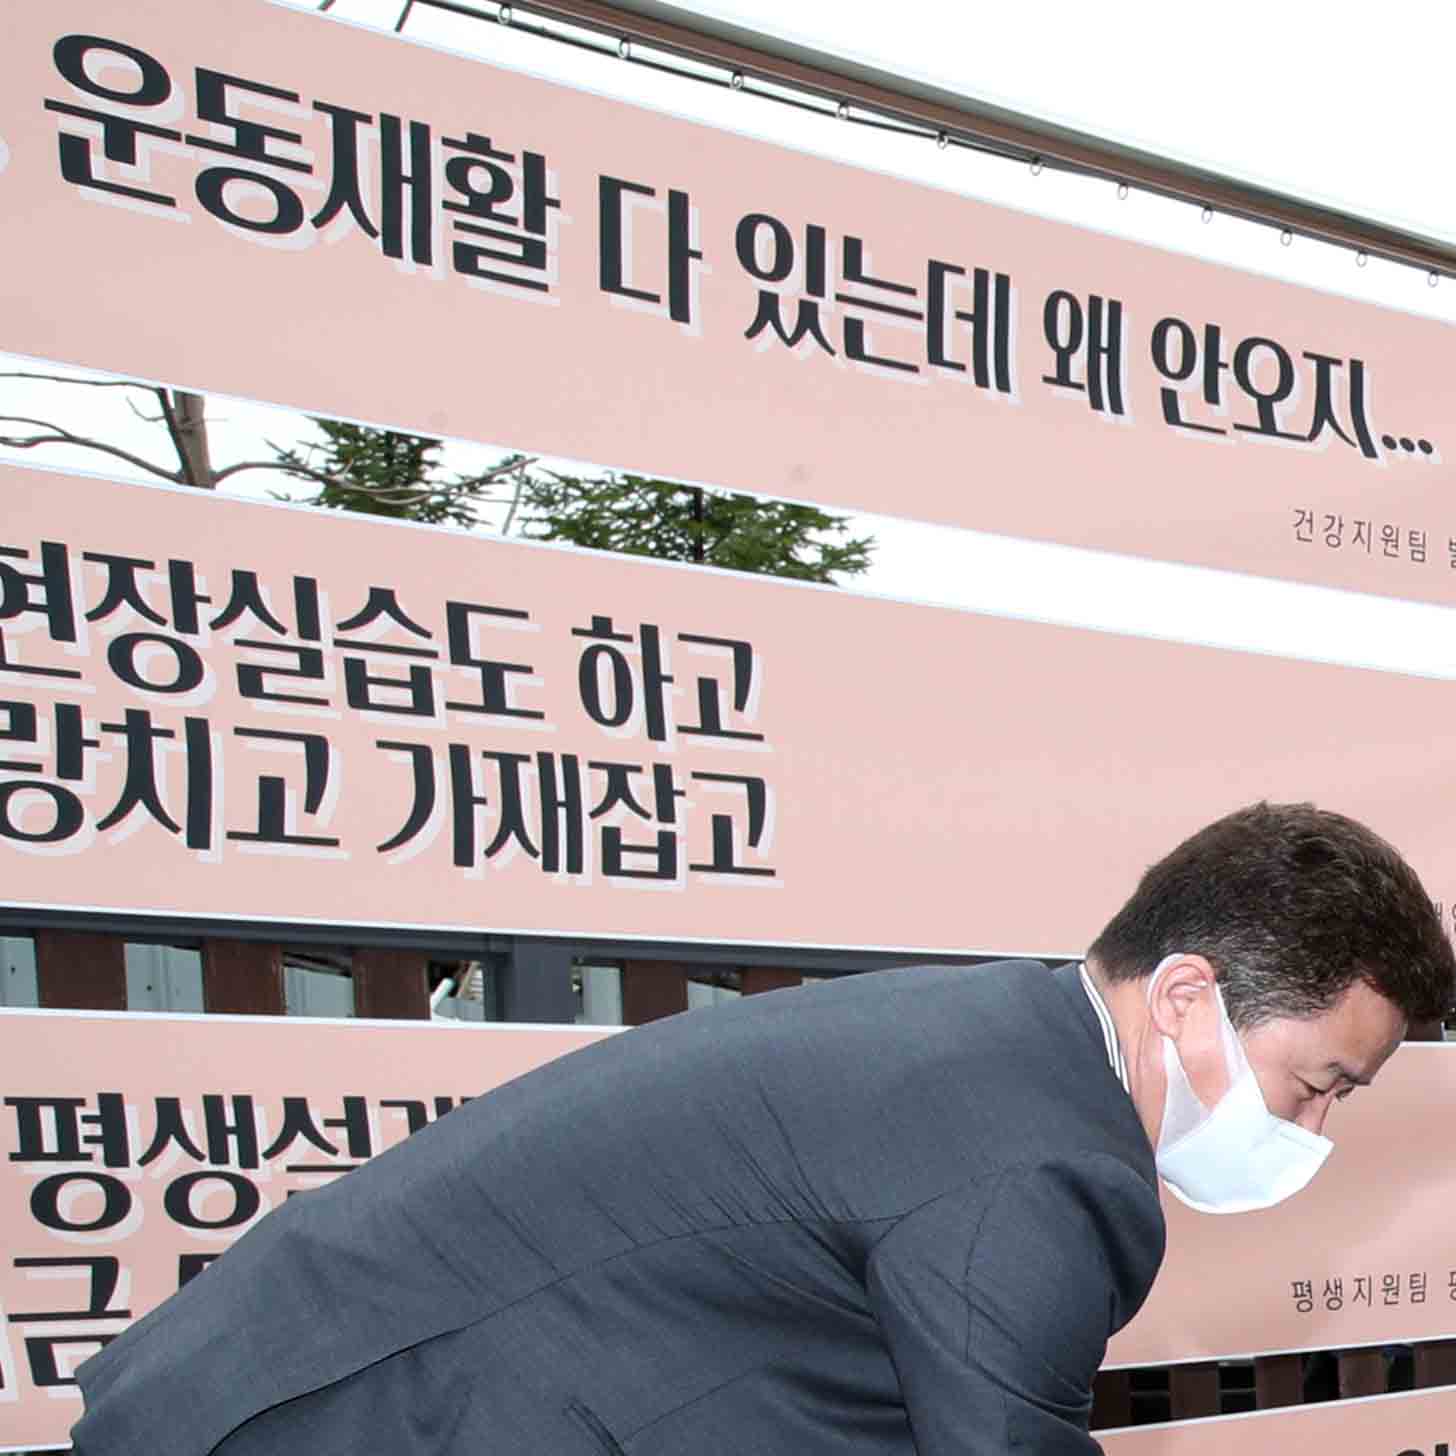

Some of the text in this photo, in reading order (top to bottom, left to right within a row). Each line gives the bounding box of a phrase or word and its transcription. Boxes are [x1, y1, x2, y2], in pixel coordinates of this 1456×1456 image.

[44, 33, 1432, 457] 운동재활 다 있는데 왜 안오지...
[1292, 507, 1430, 563] 건강지원팀
[0, 540, 763, 740] 현장실습도 하고
[376, 735, 774, 879] 가재잡고
[3, 1090, 480, 1232] 평생설
[1291, 1271, 1427, 1314] 평생지원팀
